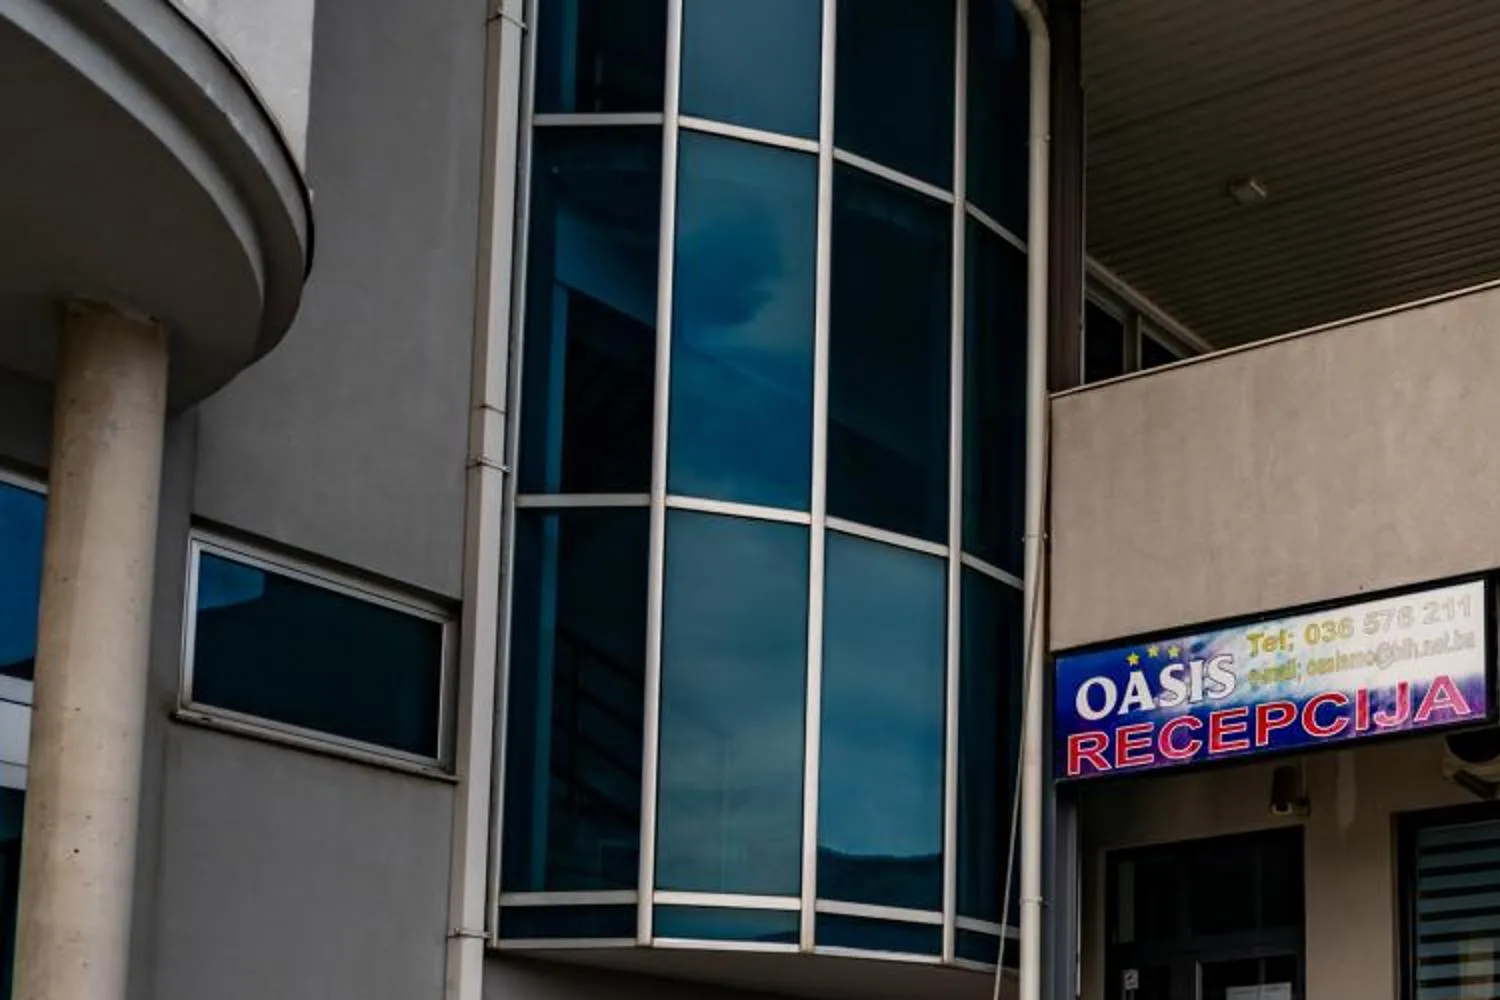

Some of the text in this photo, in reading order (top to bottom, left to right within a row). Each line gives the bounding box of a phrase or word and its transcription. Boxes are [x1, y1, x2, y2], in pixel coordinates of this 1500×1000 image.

[1304, 618, 1355, 645] 036
[1423, 594, 1472, 625] 211
[1075, 653, 1238, 721] OASIS
[1066, 674, 1472, 776] RECEPCIJA
